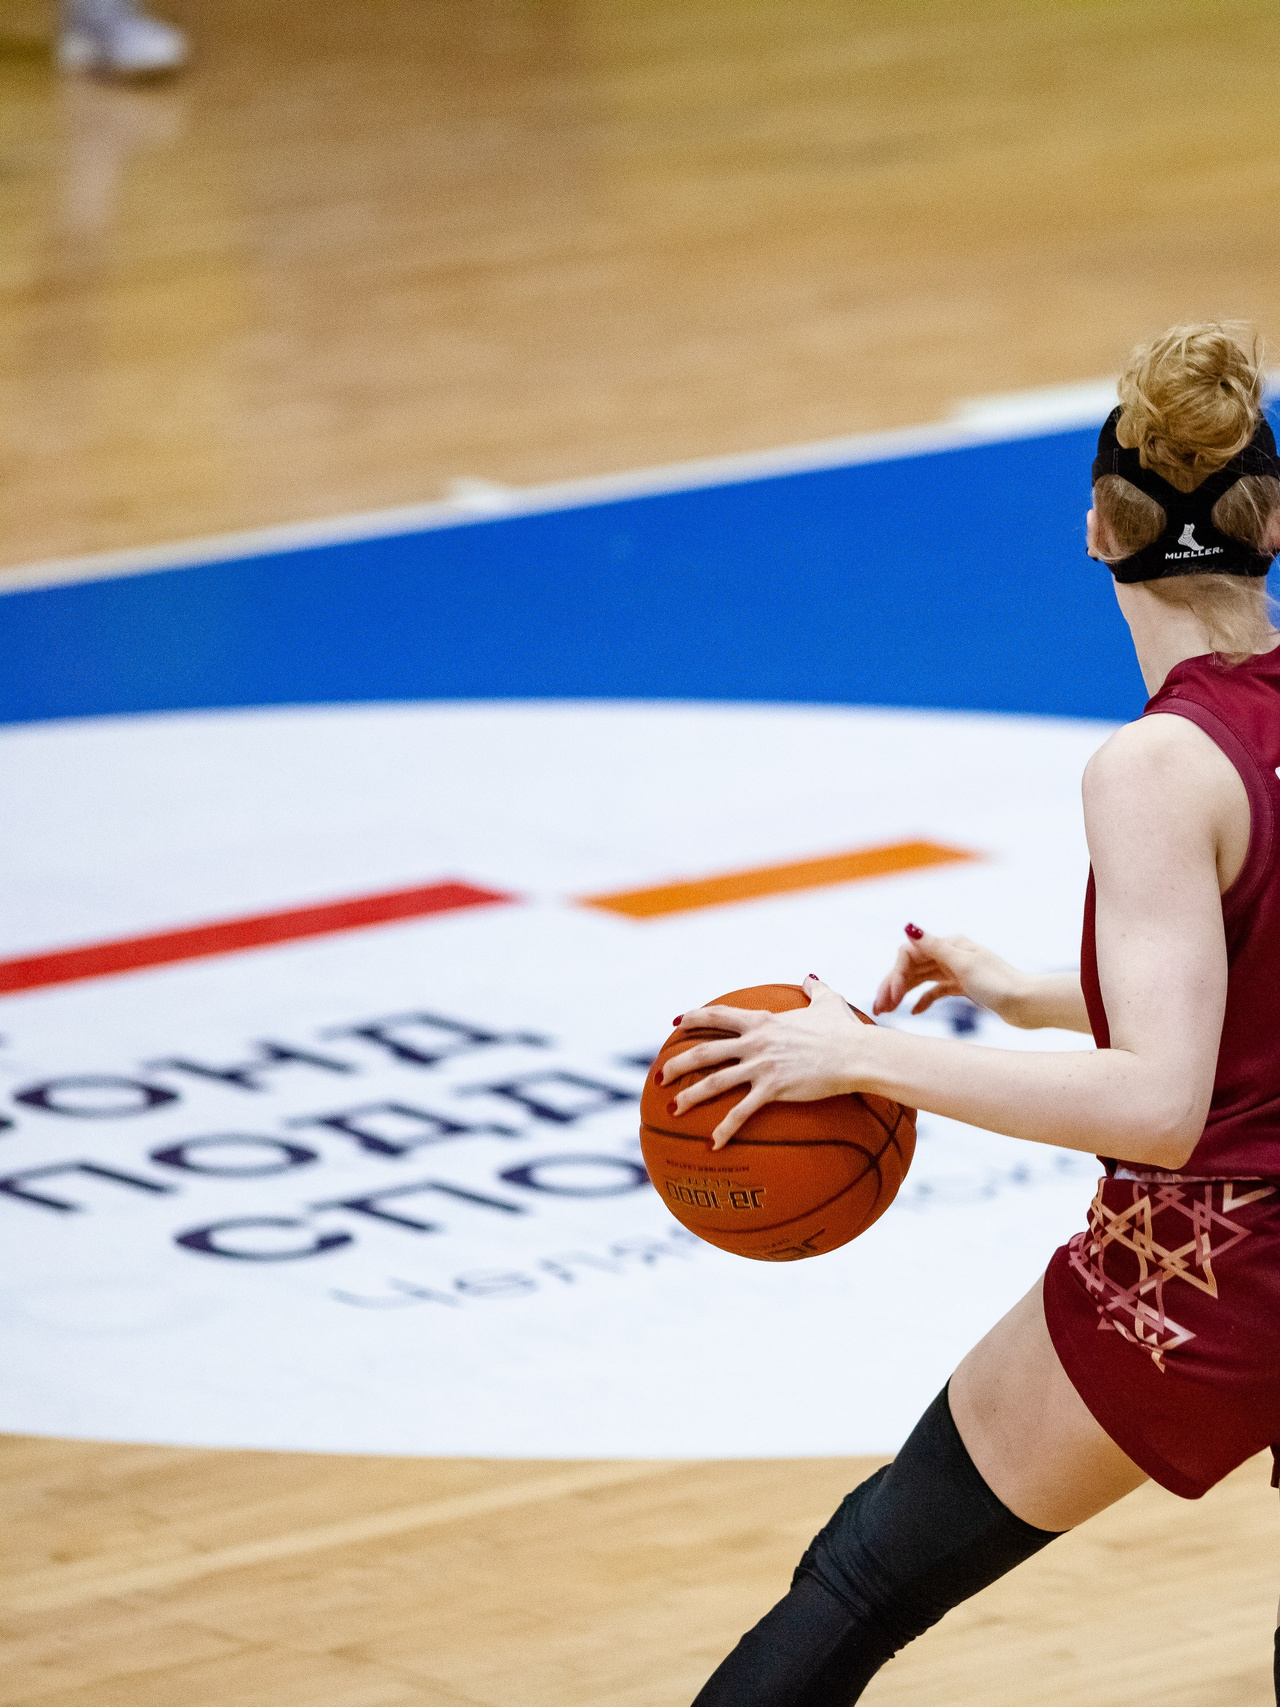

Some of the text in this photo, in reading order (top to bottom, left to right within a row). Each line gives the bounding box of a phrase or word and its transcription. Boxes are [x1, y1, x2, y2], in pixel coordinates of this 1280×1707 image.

[1164, 547, 1221, 560] MUELLER
[0, 1008, 555, 1132] ОНД
[0, 1050, 655, 1212] ПОДД
[173, 1151, 650, 1263] СПО
